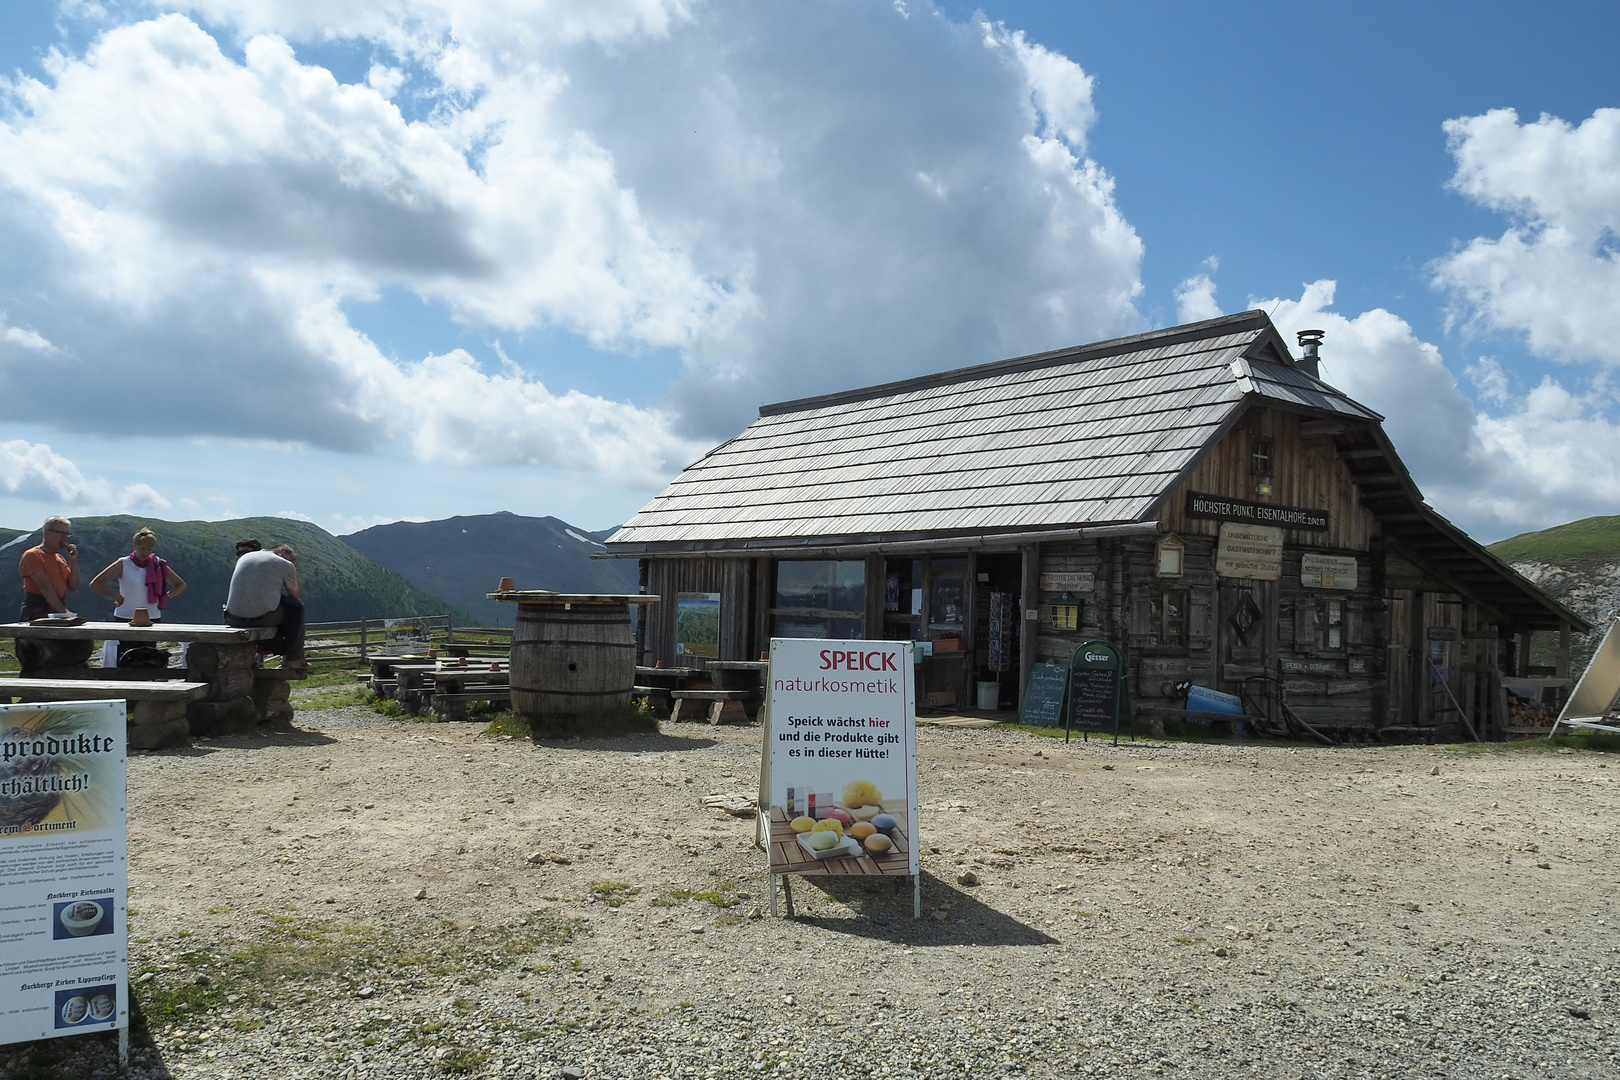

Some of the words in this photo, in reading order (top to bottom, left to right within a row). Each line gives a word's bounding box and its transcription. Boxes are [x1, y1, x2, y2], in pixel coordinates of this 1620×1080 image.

[1193, 495, 1231, 515] HÖCHSTER
[1257, 508, 1307, 524] EISENTALHÖHE
[1226, 546, 1277, 555] GASTWIRTSCHAFT
[819, 649, 898, 672] SPEICK
[1085, 651, 1109, 663] Gösser
[774, 677, 898, 694] naturkosmetik
[788, 716, 824, 728] Speick
[826, 716, 866, 727] wächst
[869, 717, 890, 728] hier
[779, 731, 800, 742] und
[804, 731, 821, 742] die
[824, 732, 874, 743] Produkte
[877, 733, 900, 746] gibt
[0, 733, 114, 763] produkte
[789, 749, 801, 758] es
[804, 747, 815, 758] in
[818, 747, 852, 758] dieser
[855, 748, 889, 759] Hütte!
[21, 820, 76, 833] Sortiment
[46, 892, 78, 900] Nockberge
[80, 887, 115, 896] Zirbensalbe
[20, 982, 54, 992] Nockberge
[55, 979, 76, 987] Zirben
[77, 973, 116, 984] Lippenpflege
